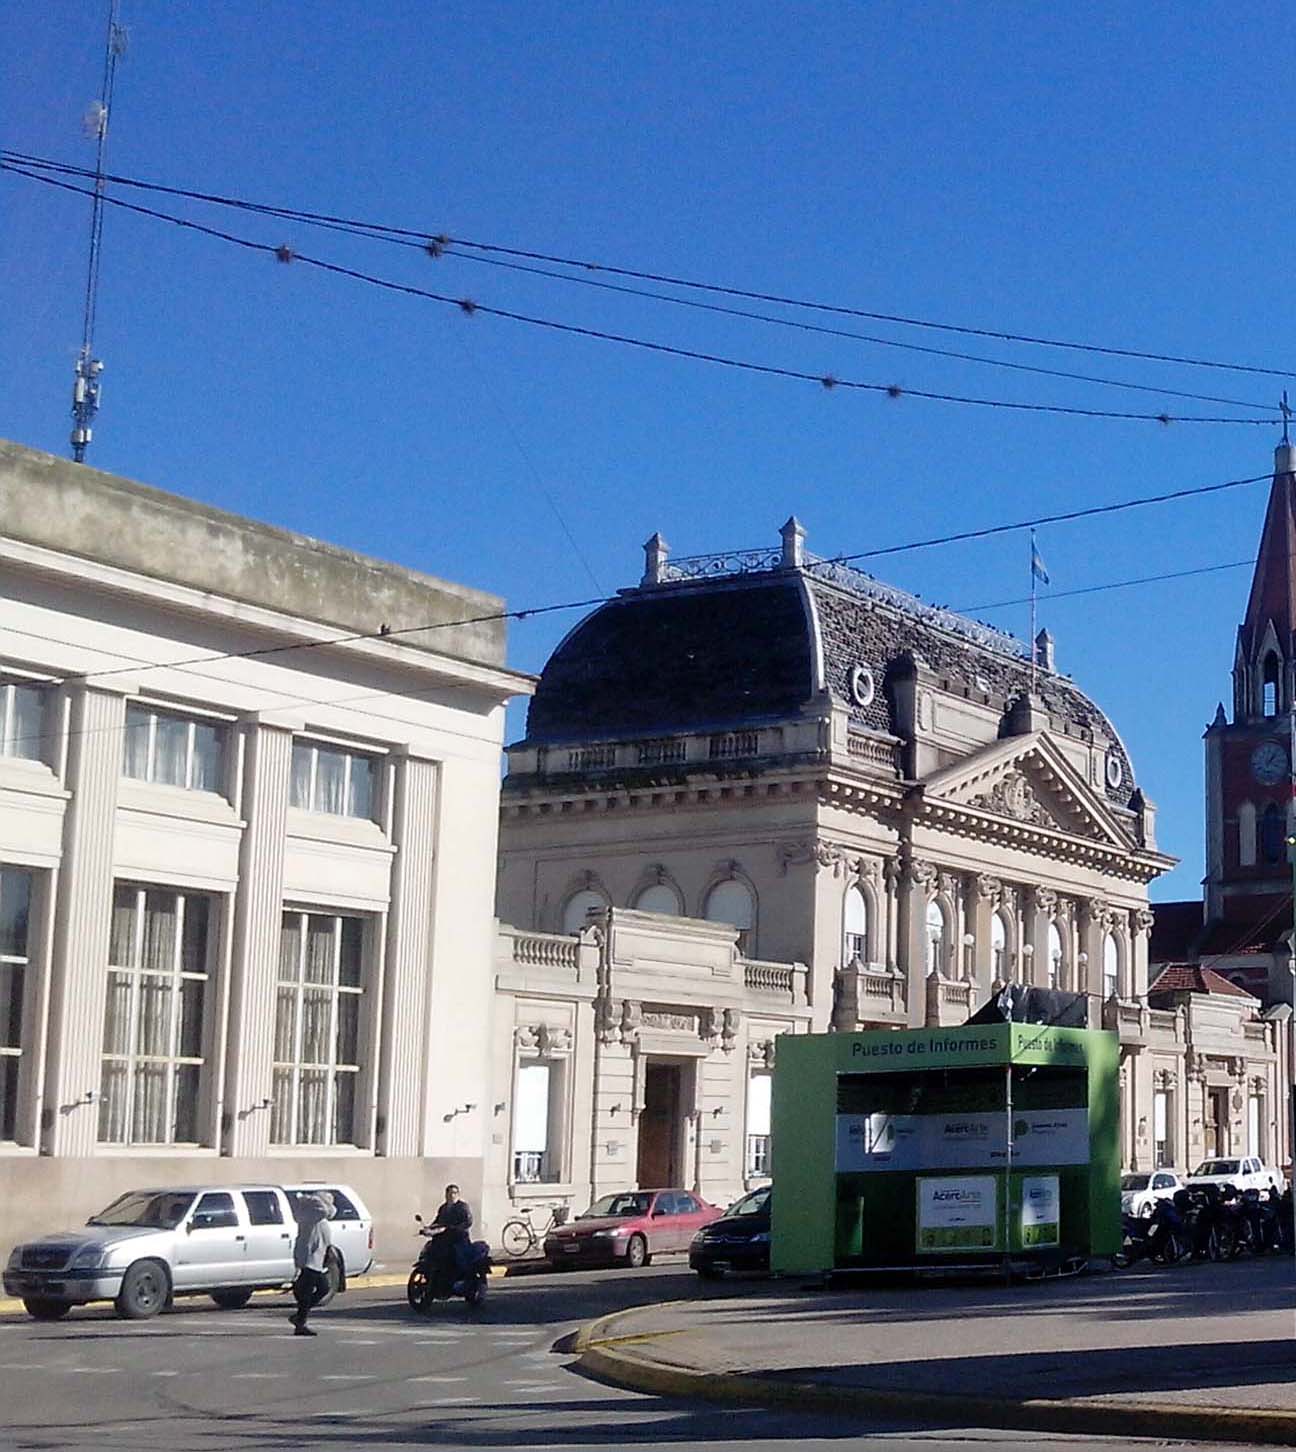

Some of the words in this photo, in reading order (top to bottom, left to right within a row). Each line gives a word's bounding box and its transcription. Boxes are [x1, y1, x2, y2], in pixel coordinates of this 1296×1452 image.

[852, 1042, 903, 1056] Puesto
[907, 1040, 926, 1054] de
[930, 1038, 998, 1053] Informes
